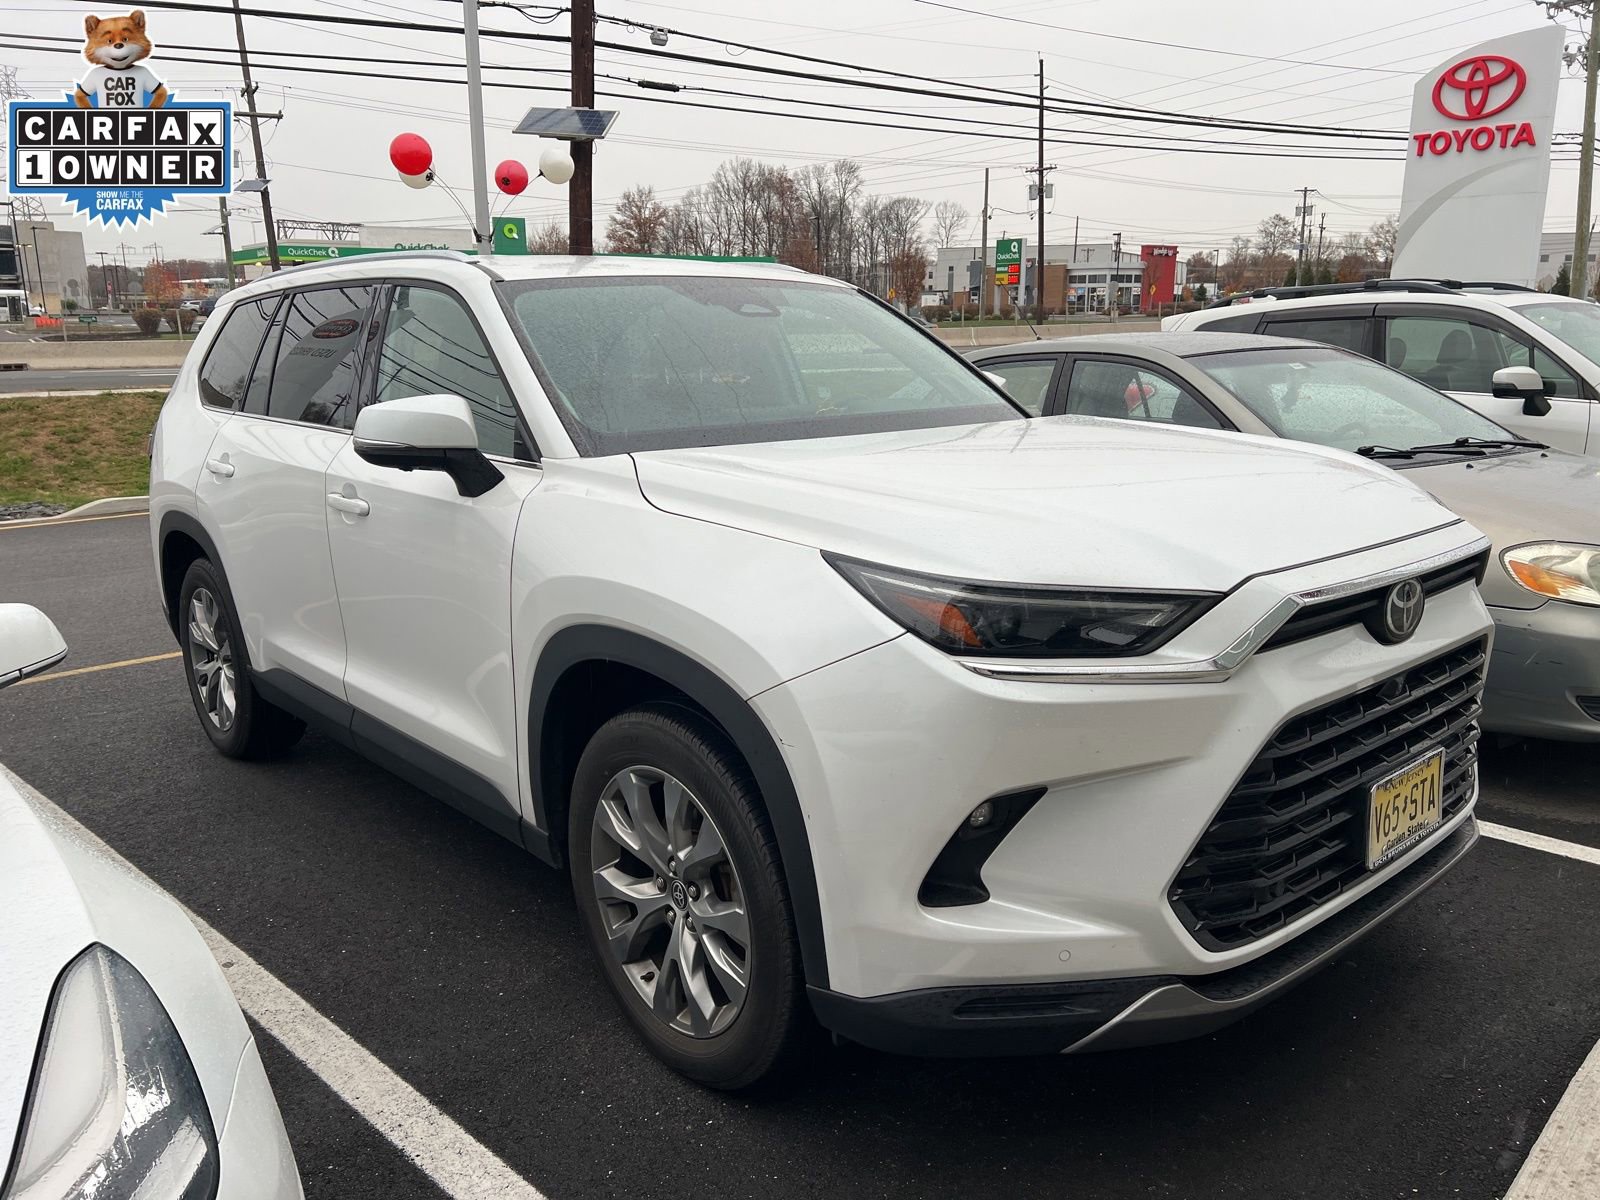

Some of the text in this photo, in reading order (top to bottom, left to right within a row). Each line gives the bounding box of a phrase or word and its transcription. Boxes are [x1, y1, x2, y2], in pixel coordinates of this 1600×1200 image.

[1413, 122, 1536, 157] TOYOTA
[288, 247, 327, 256] QuickChek
[1407, 819, 1426, 837] State
[1420, 821, 1440, 838] TOYOTA
